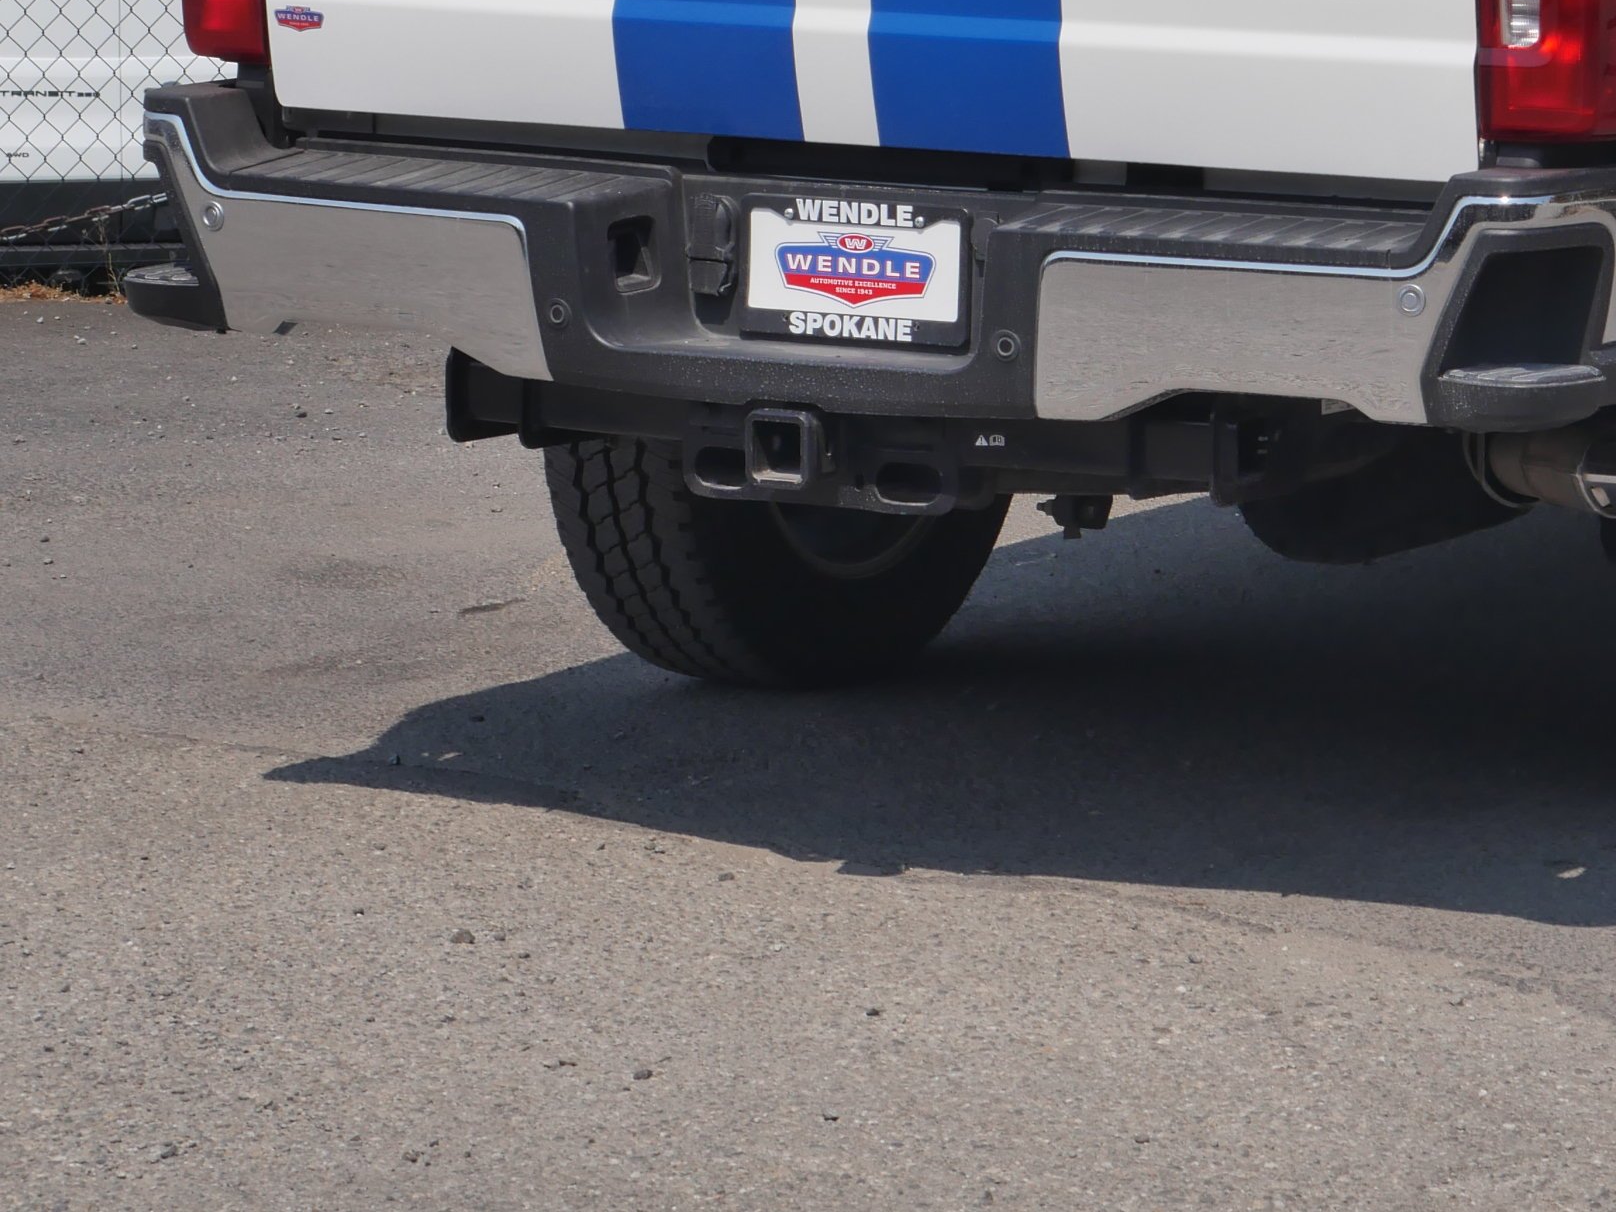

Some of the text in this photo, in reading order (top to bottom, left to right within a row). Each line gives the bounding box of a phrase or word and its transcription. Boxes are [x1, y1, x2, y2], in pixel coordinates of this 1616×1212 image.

[277, 12, 320, 22] WENDLE
[795, 198, 914, 227] WENDLE
[786, 253, 920, 279] WENDLE
[810, 277, 897, 289] AUTOMOTIVE EXCELLENCE
[835, 286, 856, 294] SINCE
[789, 311, 913, 342] SPOKANE
